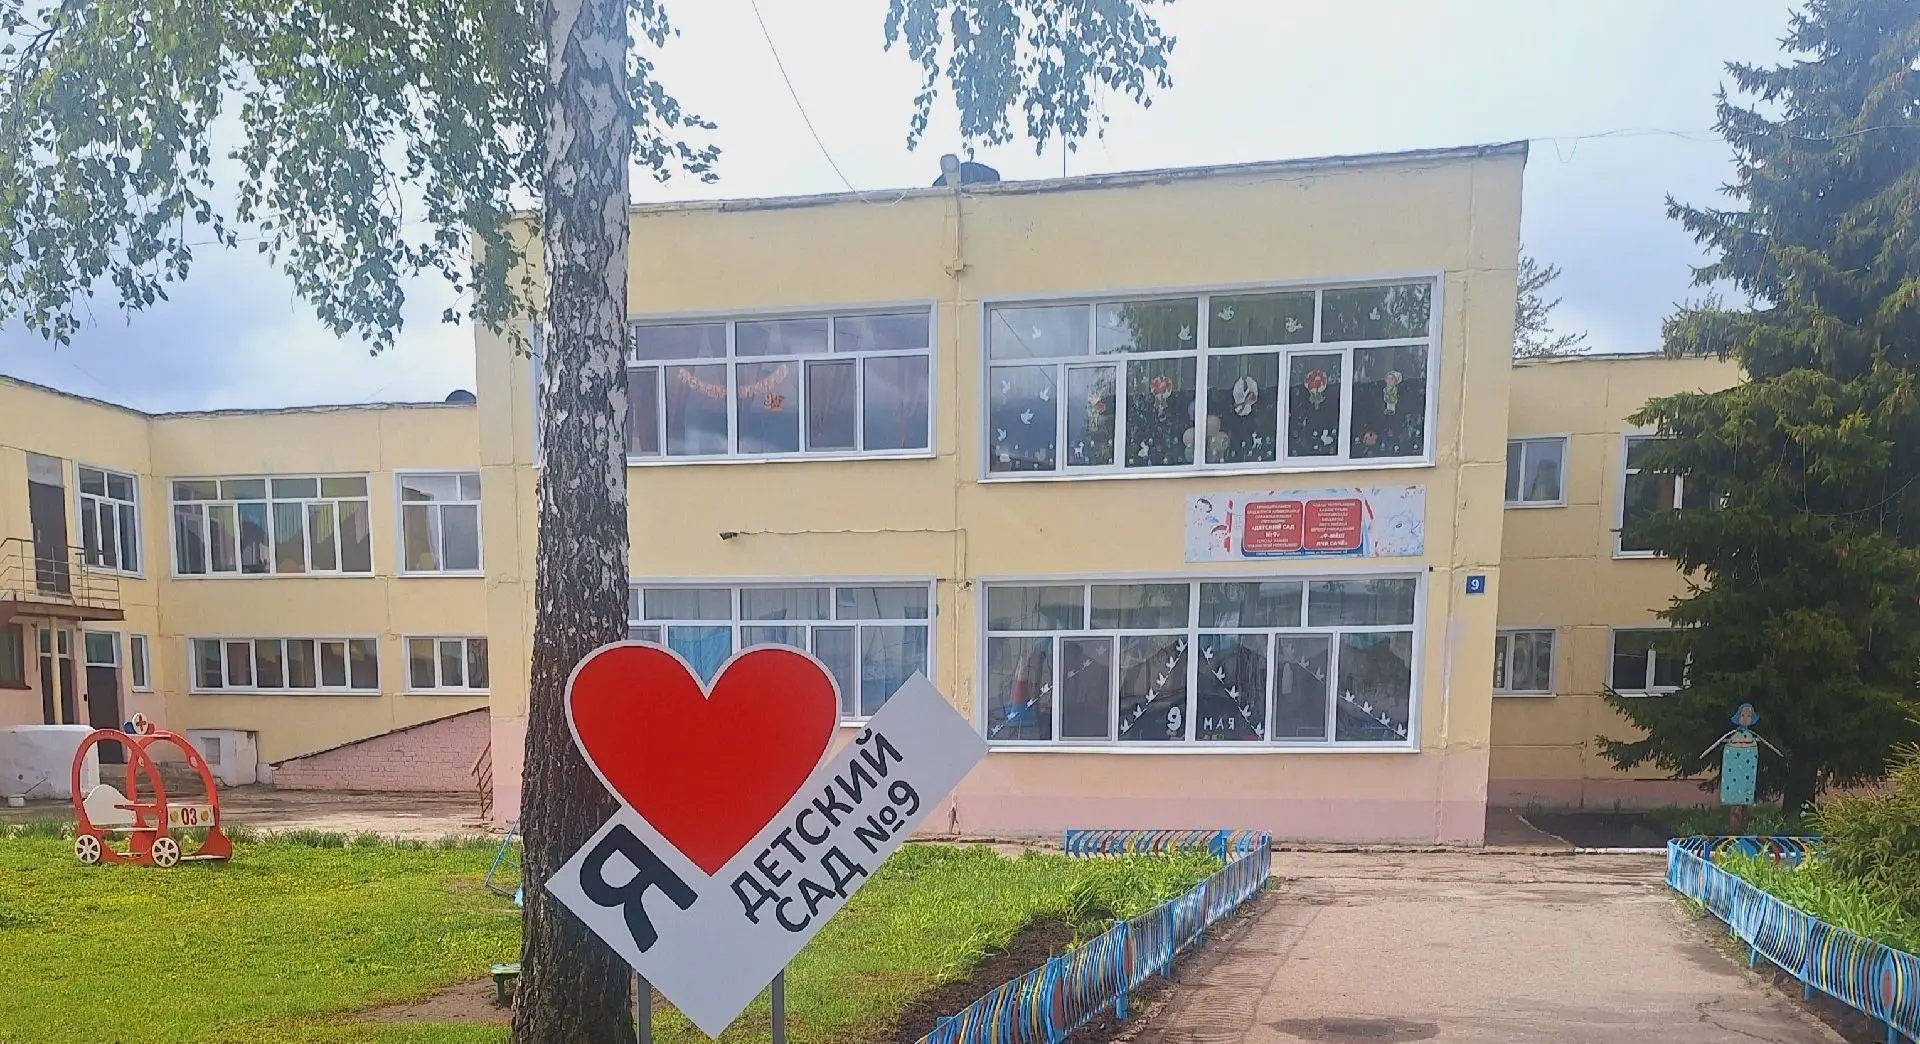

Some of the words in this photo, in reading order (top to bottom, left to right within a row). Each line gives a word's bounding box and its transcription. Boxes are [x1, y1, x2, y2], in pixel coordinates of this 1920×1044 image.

[1471, 579, 1480, 590] 9
[1167, 706, 1182, 731] 9
[1203, 717, 1235, 730] МАЯ
[181, 807, 198, 826] 03
[730, 727, 904, 925] ДЕТСКИЙ
[579, 823, 699, 954] Я
[775, 845, 869, 933] САД
[853, 779, 921, 855] №9
